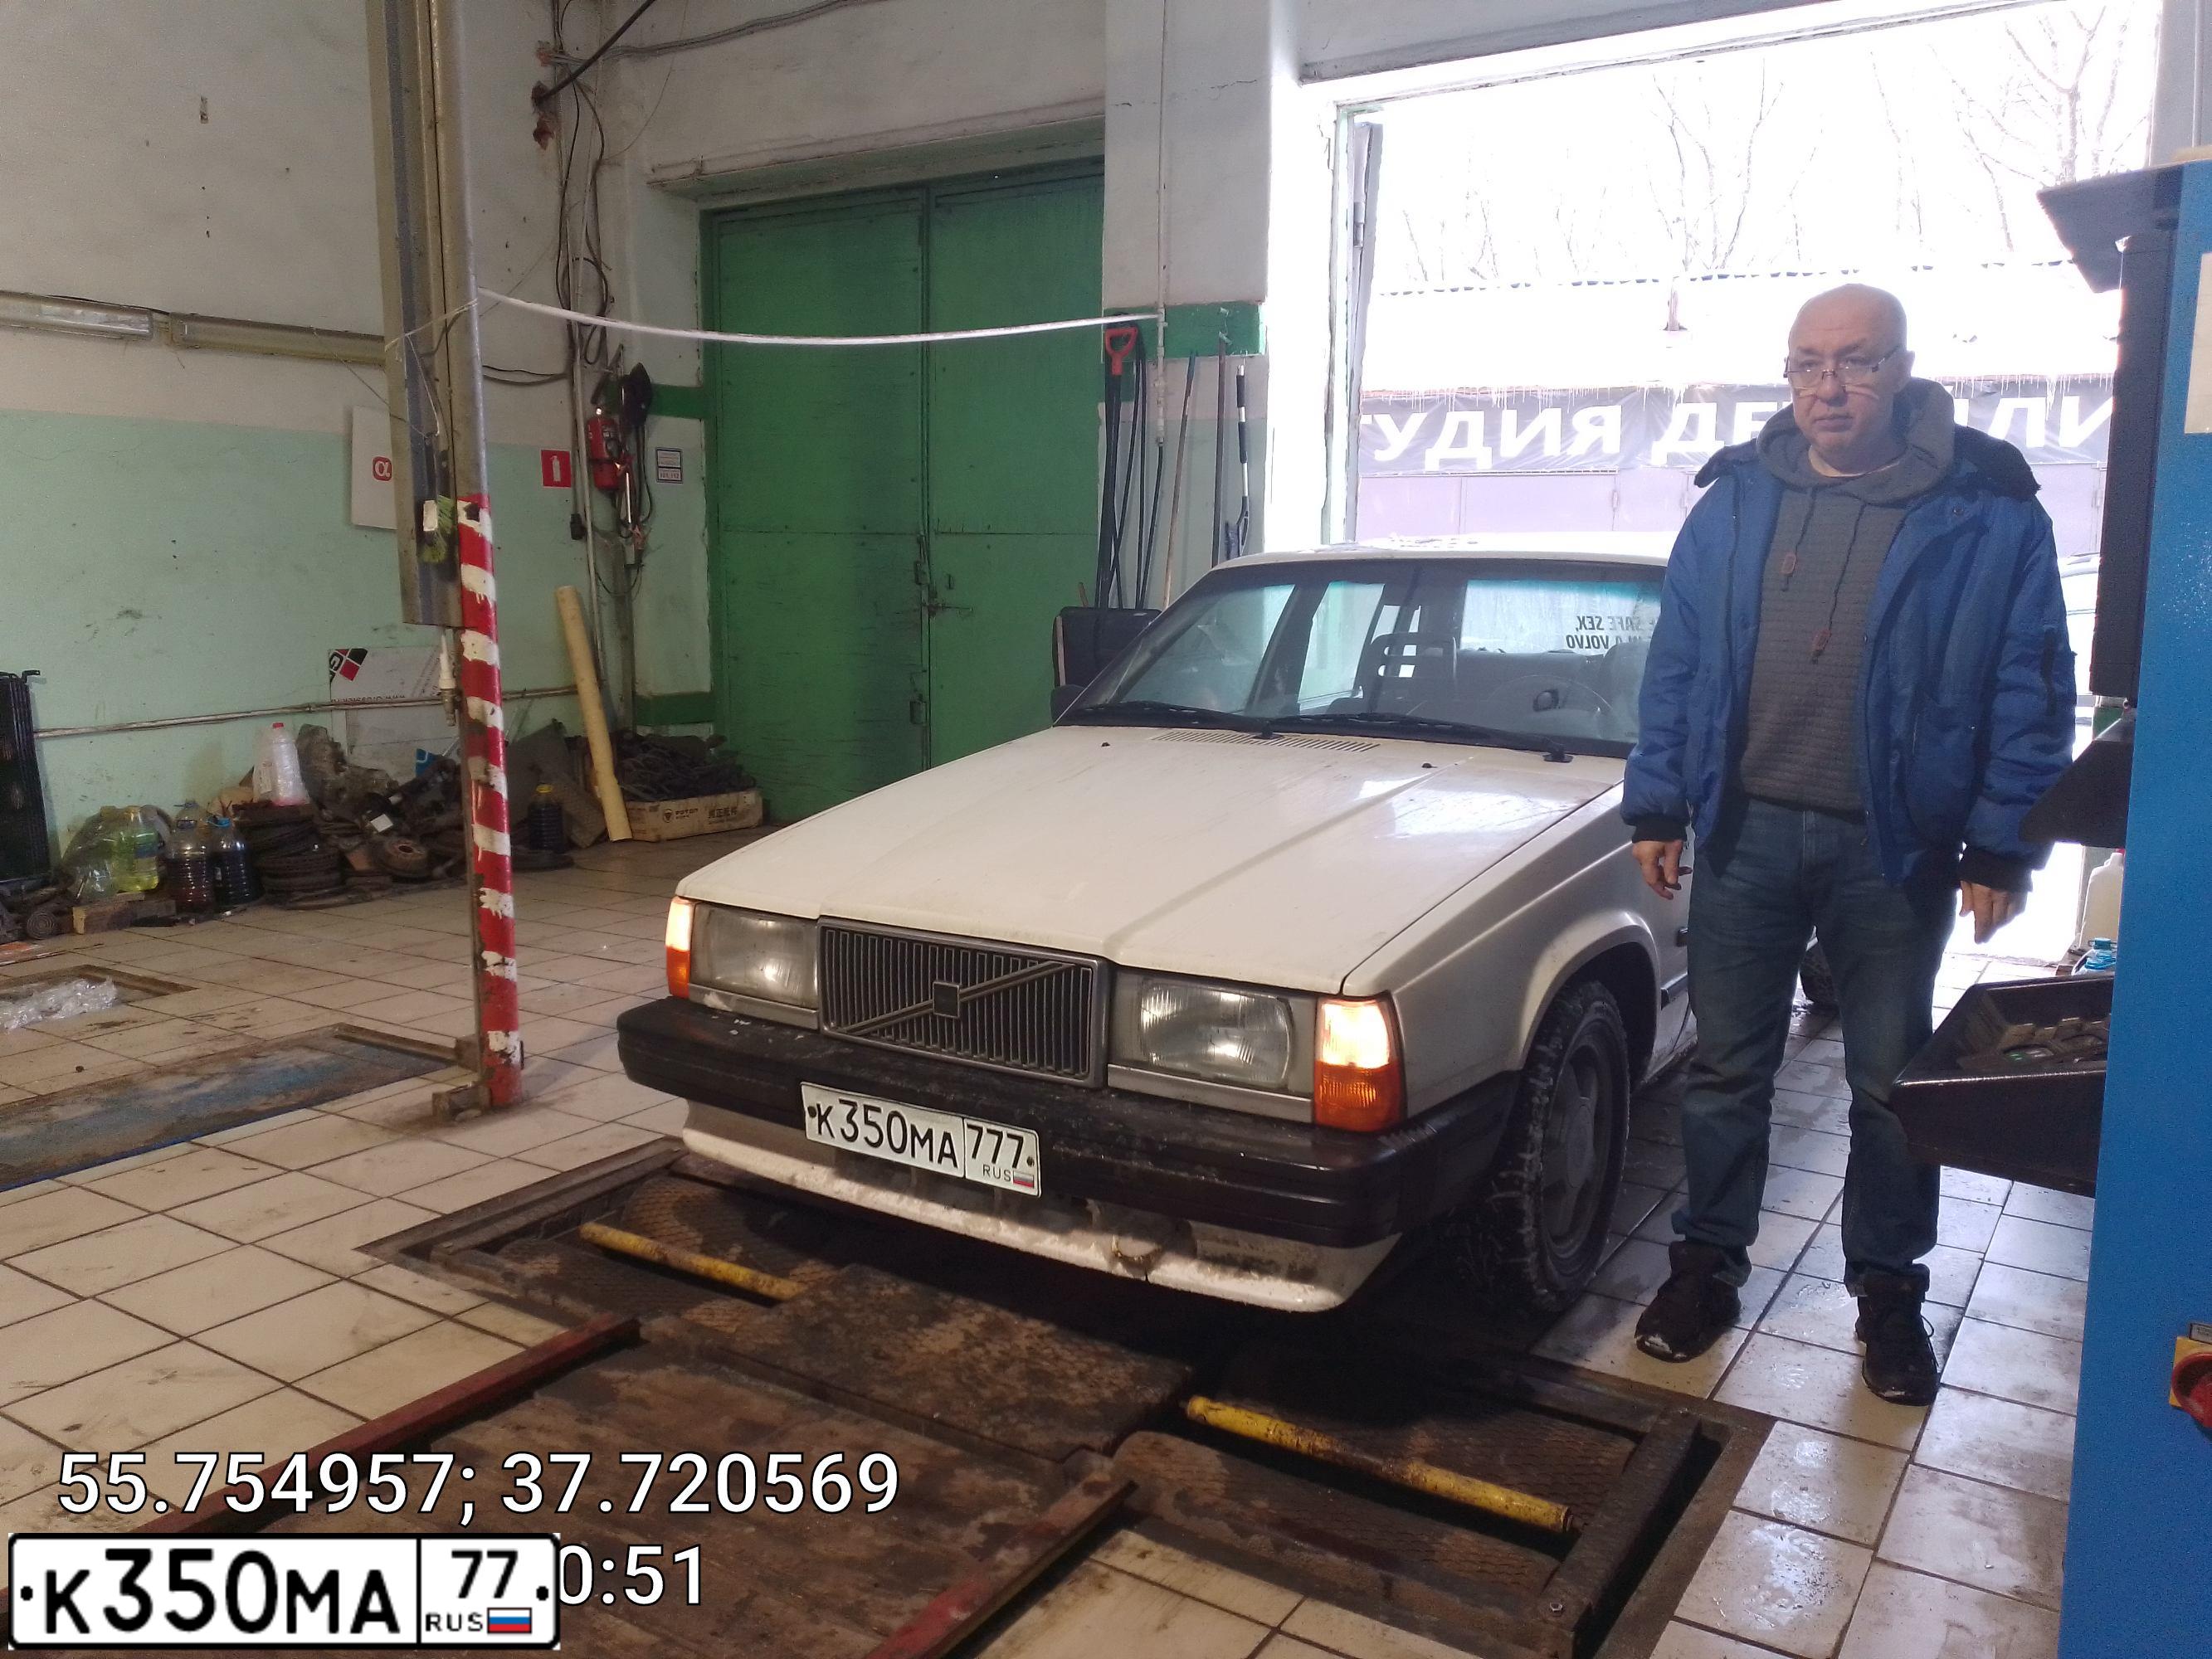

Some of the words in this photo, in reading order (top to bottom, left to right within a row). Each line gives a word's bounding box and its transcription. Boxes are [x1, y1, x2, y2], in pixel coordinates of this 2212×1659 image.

[1361, 405, 1623, 471] УДИЯ
[816, 1097, 958, 1169] К350МА
[966, 1123, 1025, 1169] 777
[982, 1164, 1011, 1183] RUS
